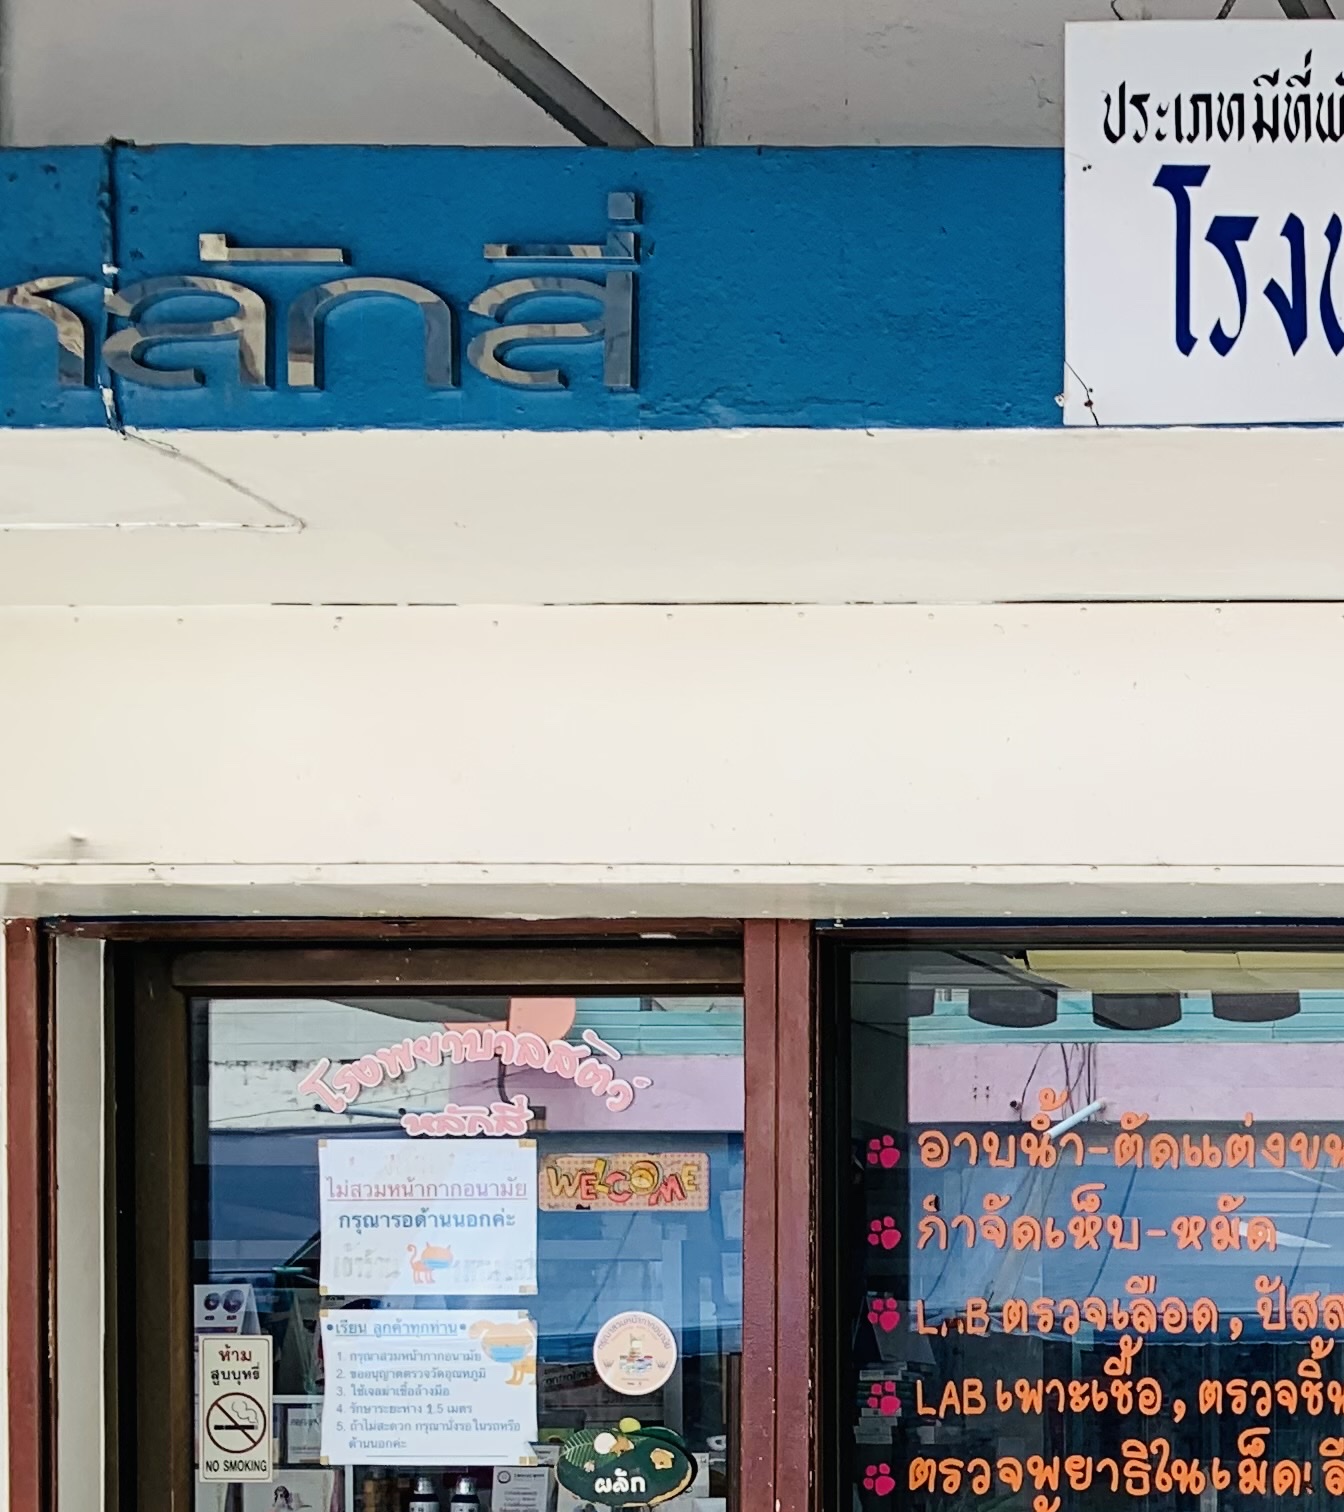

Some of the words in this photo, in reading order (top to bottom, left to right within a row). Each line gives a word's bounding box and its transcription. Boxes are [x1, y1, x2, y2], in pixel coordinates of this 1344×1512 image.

[400, 1094, 534, 1137] หลักสี่
[326, 1175, 528, 1199] ไม่สวมหน้ากากอนามัย
[546, 1158, 700, 1206] WELCOME
[338, 1207, 517, 1236] กรุณารอด้านนอกค่ะ
[916, 1182, 1278, 1253] กำจัดเห็บ-หมัด
[335, 1320, 367, 1335] เรียน
[373, 1318, 458, 1338] ลูกค้าทุกท่าน
[218, 1343, 253, 1362] ห้าม
[210, 1362, 261, 1386] สูบบุหรี่
[915, 1378, 987, 1417] LAB
[205, 1460, 220, 1472] NO
[223, 1460, 268, 1473] SMOKING
[594, 1467, 646, 1494] ผลัก
